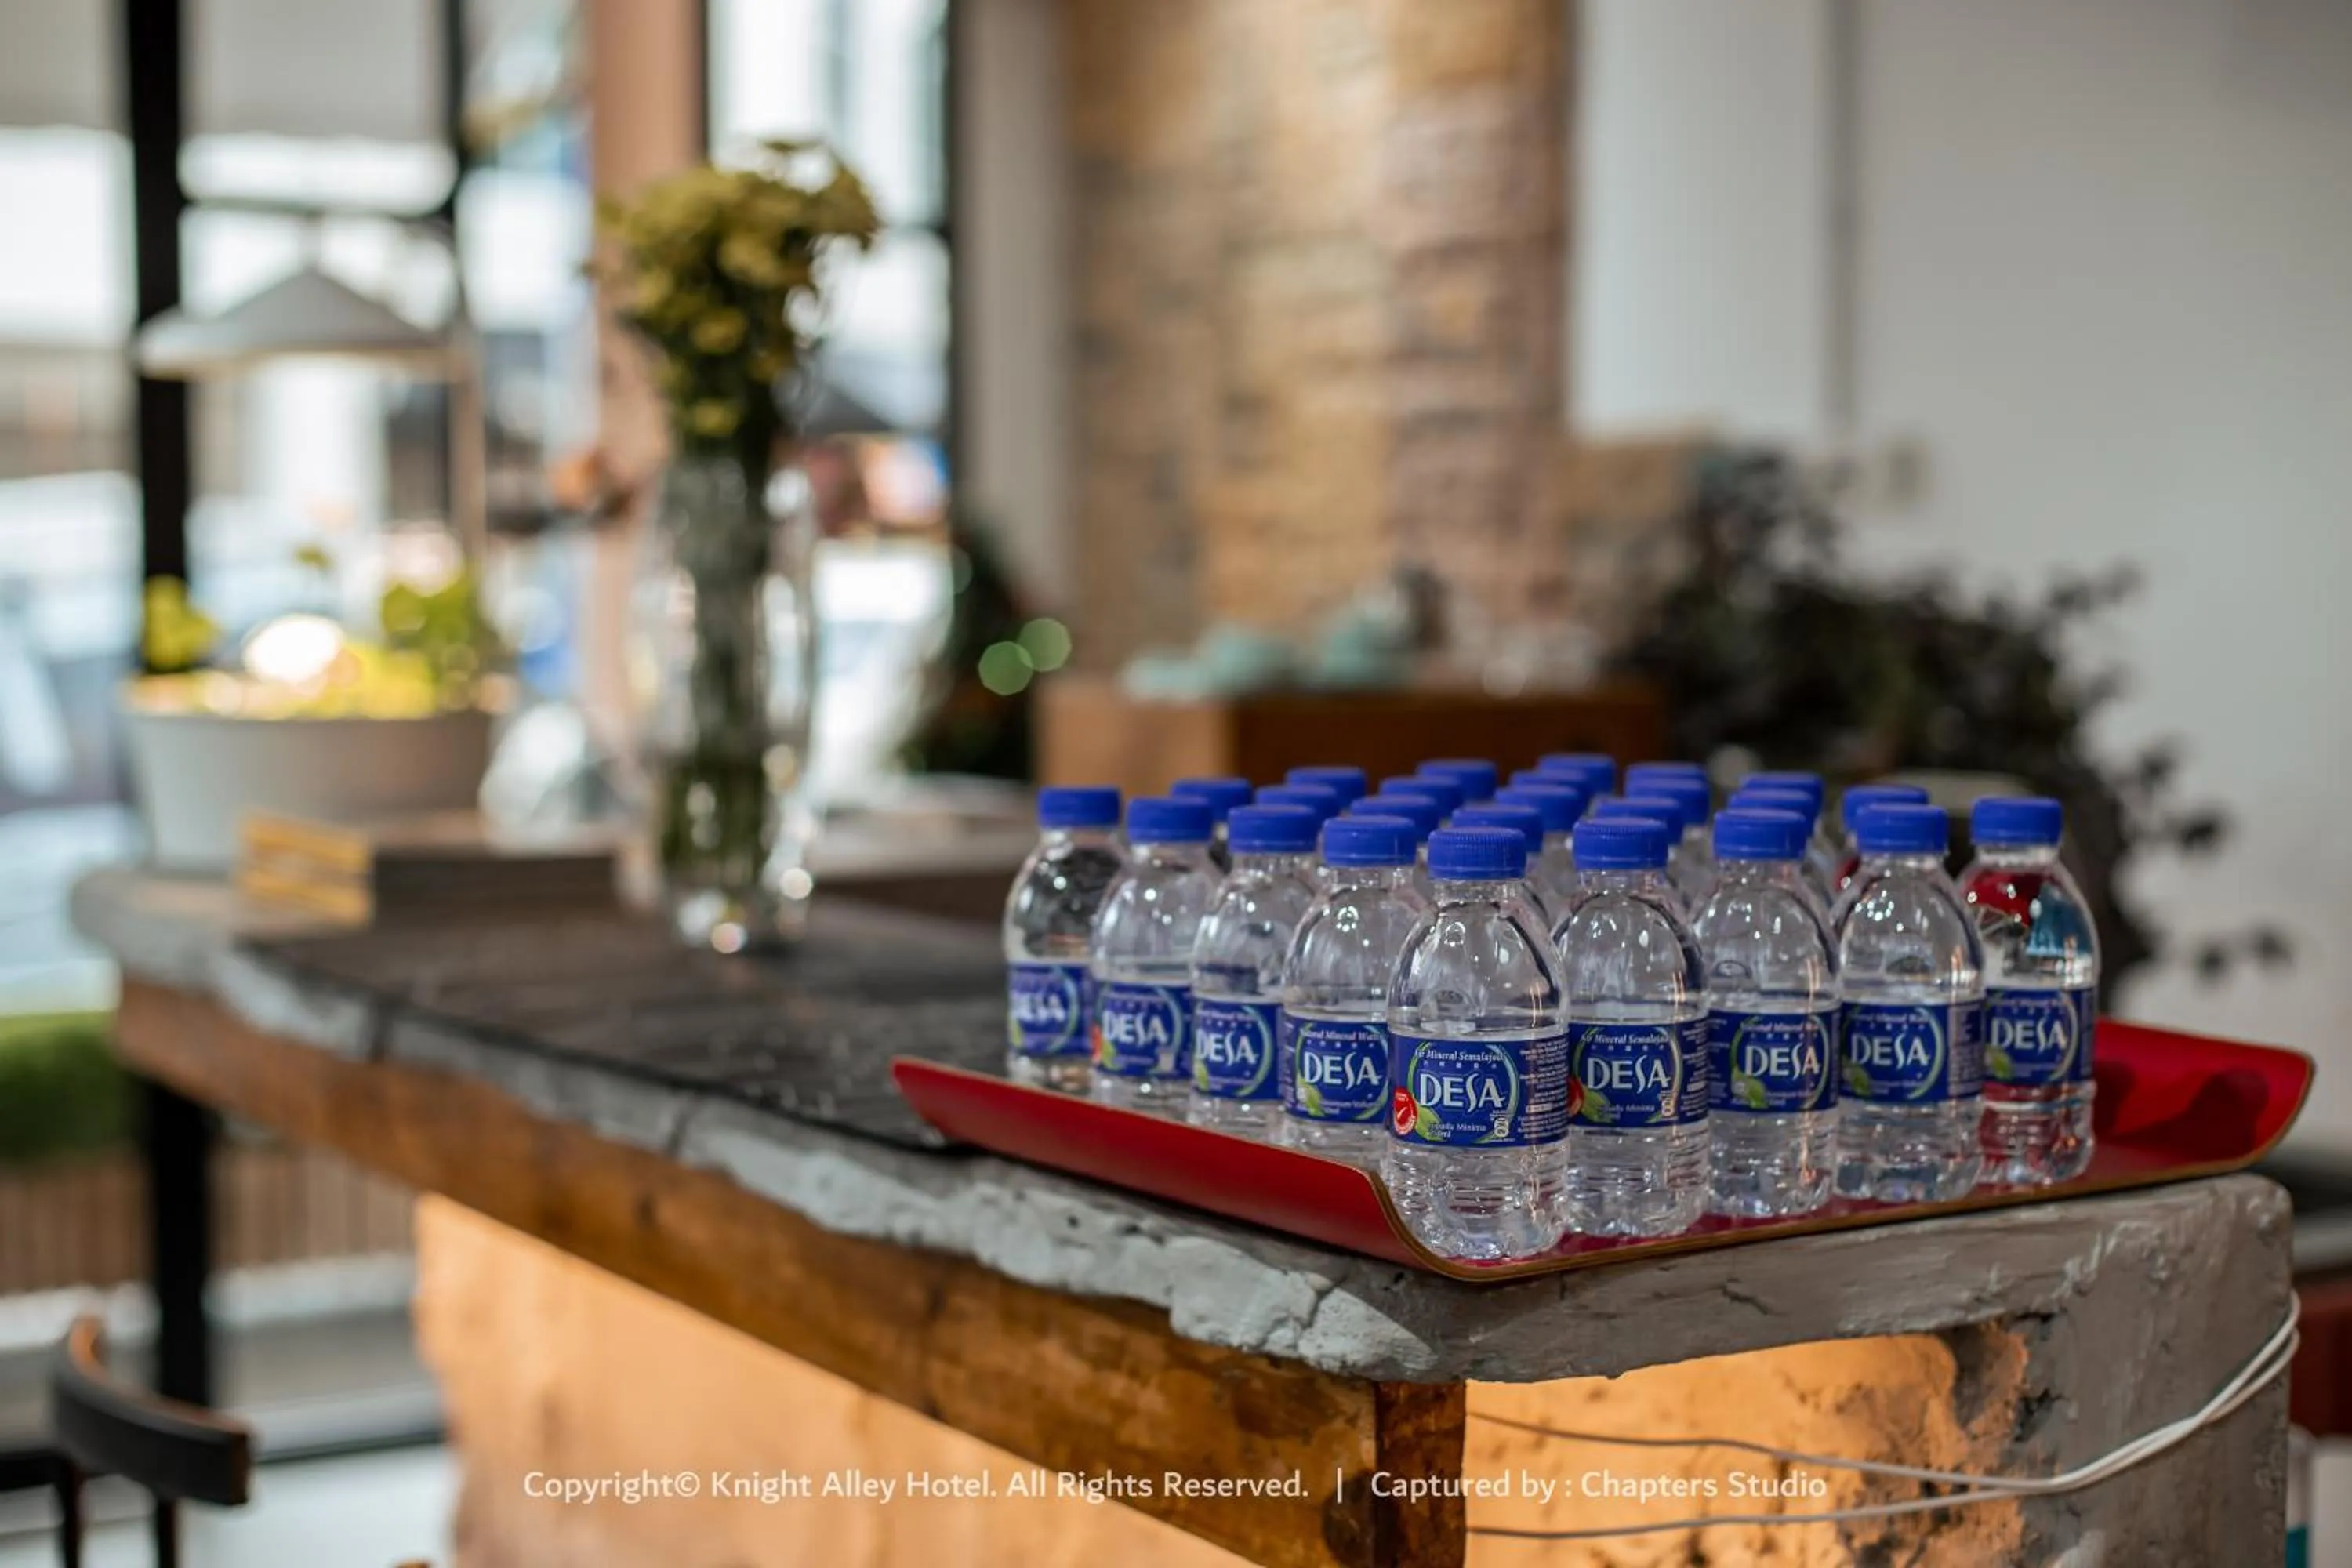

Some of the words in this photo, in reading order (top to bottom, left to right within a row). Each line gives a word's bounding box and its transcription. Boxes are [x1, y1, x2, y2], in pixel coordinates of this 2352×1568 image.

[1102, 1010, 1168, 1047] DESA
[1196, 1028, 1260, 1066] DESA
[1991, 1014, 2068, 1054] DESA
[1426, 1048, 1458, 1061] Mineral
[1744, 1043, 1821, 1080] DESA
[1851, 1032, 1930, 1069] DESA
[1303, 1051, 1383, 1091] DESA
[1587, 1055, 1671, 1094] DESA
[1420, 1072, 1507, 1113] DESA
